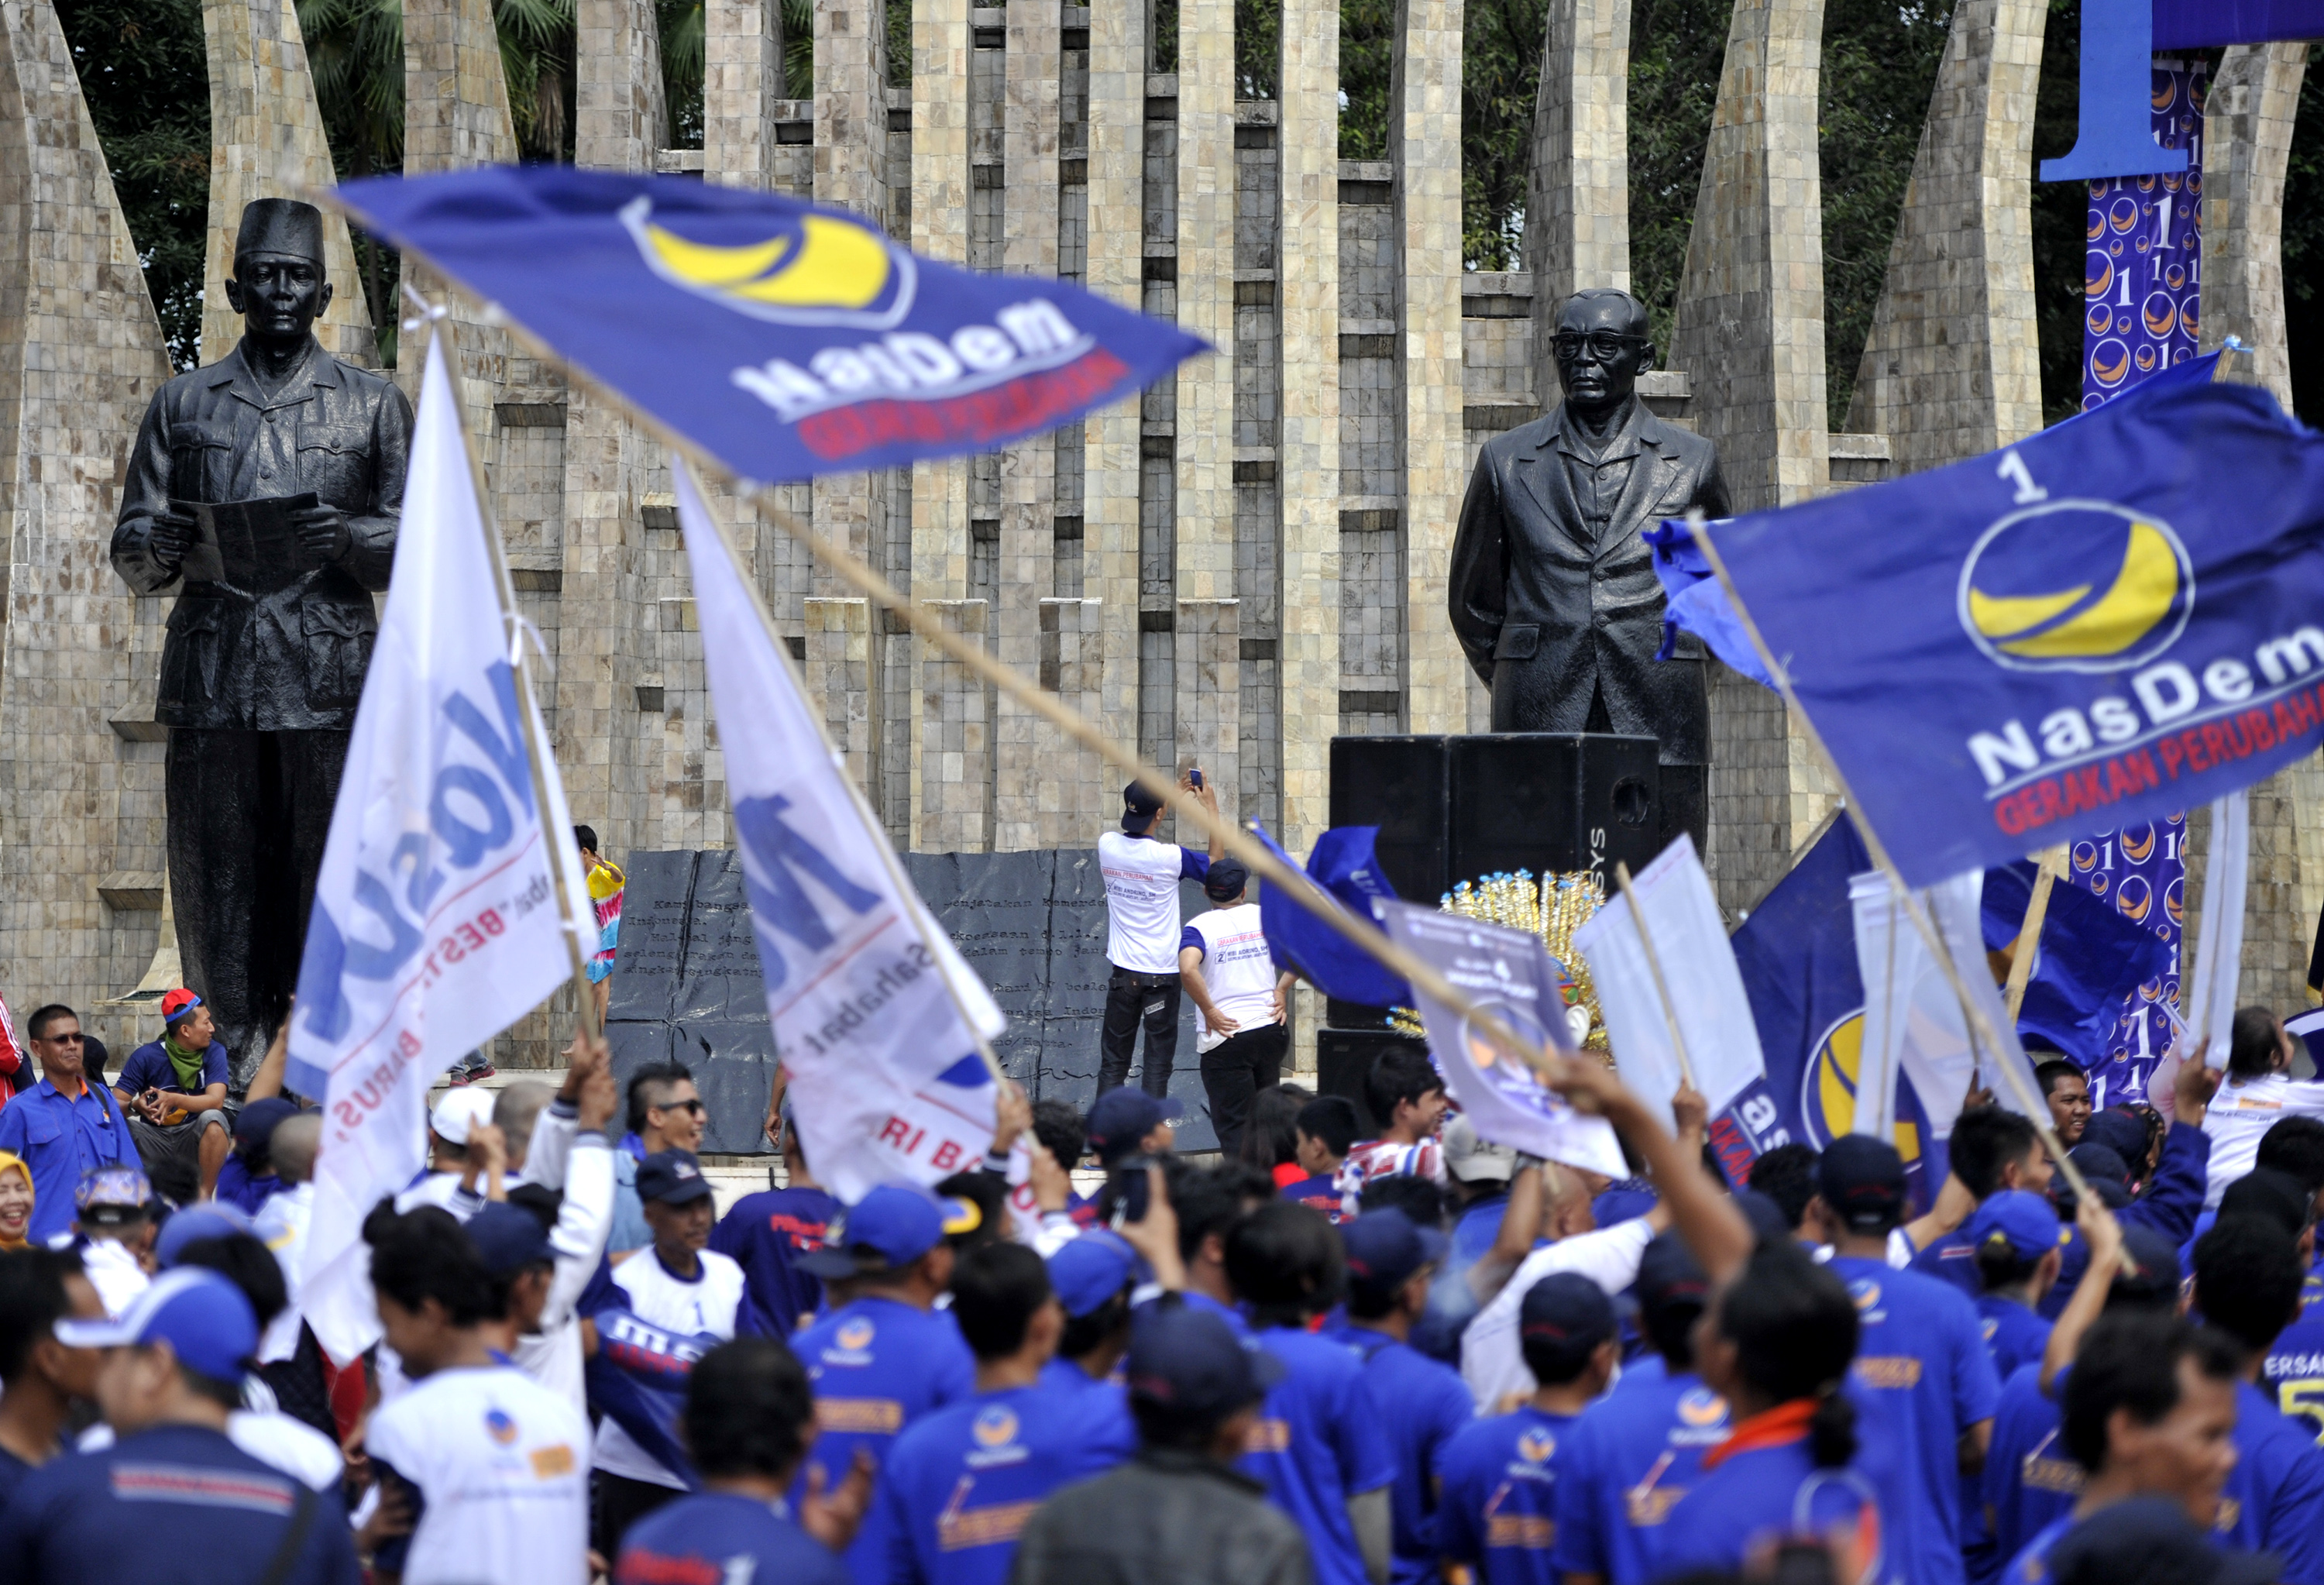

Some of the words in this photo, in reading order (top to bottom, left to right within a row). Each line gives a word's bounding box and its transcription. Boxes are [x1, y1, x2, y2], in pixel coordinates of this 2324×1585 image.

[2189, 134, 2202, 166] 1
[2153, 195, 2175, 249] 1
[2151, 255, 2161, 280] 1
[2189, 258, 2200, 284] 1
[2115, 266, 2134, 307] 1
[2159, 342, 2170, 370] 1
[1996, 450, 2048, 505] 1
[1966, 626, 2324, 788] NasDem
[1995, 748, 2160, 837] GERAKAN
[2102, 841, 2115, 870] 1
[2164, 831, 2177, 860] 1
[696, 899, 749, 913] bangsa
[627, 916, 707, 927] Indonesa.
[950, 930, 1030, 941] ekoeasaan
[1218, 954, 1224, 963] 2
[1065, 982, 1108, 992] boela
[1064, 1006, 1106, 1016] Indon
[2130, 1006, 2156, 1058] 1
[2130, 1064, 2143, 1091] 1
[2092, 1074, 2106, 1113] 1
